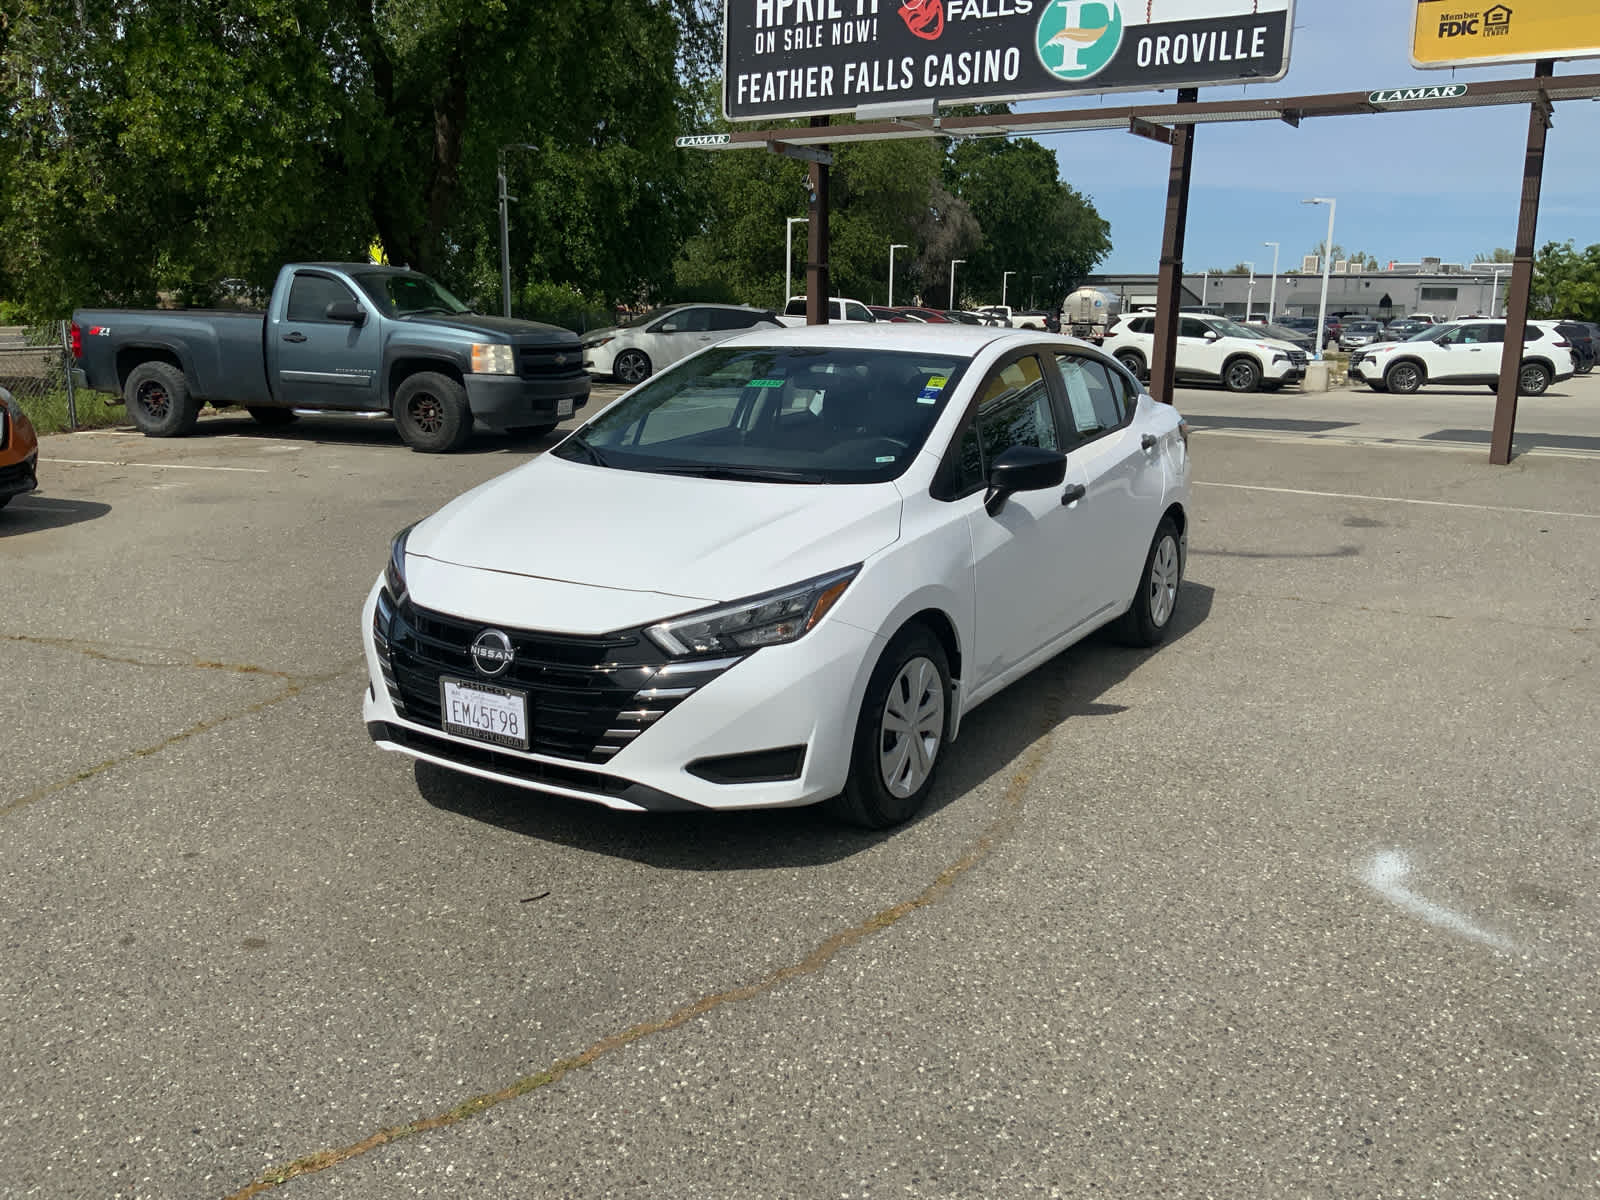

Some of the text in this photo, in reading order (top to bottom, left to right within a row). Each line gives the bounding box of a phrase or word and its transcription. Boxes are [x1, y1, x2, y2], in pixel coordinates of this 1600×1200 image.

[947, 0, 1033, 22] FALLS
[1440, 12, 1479, 21] Member
[755, 18, 878, 54] ON SALE NOW!
[1438, 19, 1479, 38] FDIC
[1136, 26, 1267, 67] OROVILLE
[737, 47, 1020, 105] FEATHER FALLS CASINO
[1377, 86, 1457, 101] LAMAR
[680, 136, 725, 146] LAMAR
[470, 645, 514, 660] NISSAN
[452, 700, 518, 735] EM45F98
